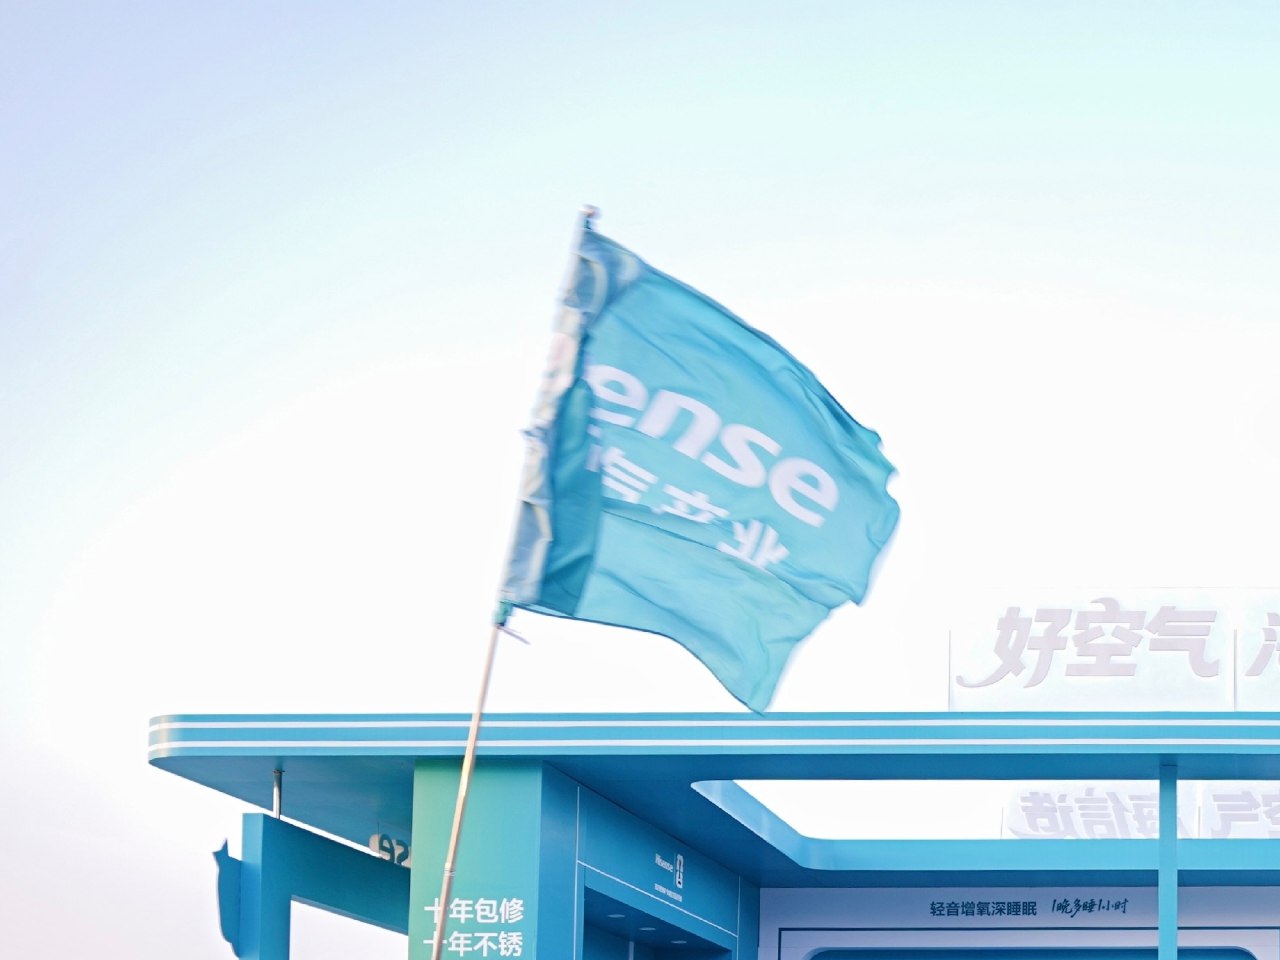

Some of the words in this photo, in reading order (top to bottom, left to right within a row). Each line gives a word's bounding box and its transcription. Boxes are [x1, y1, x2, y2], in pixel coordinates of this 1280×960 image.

[956, 597, 1220, 688] 好空气
[424, 897, 524, 924] 十年包修
[930, 901, 1037, 917] 轻音增氧深睡眠
[423, 931, 523, 957] 十年不锈
